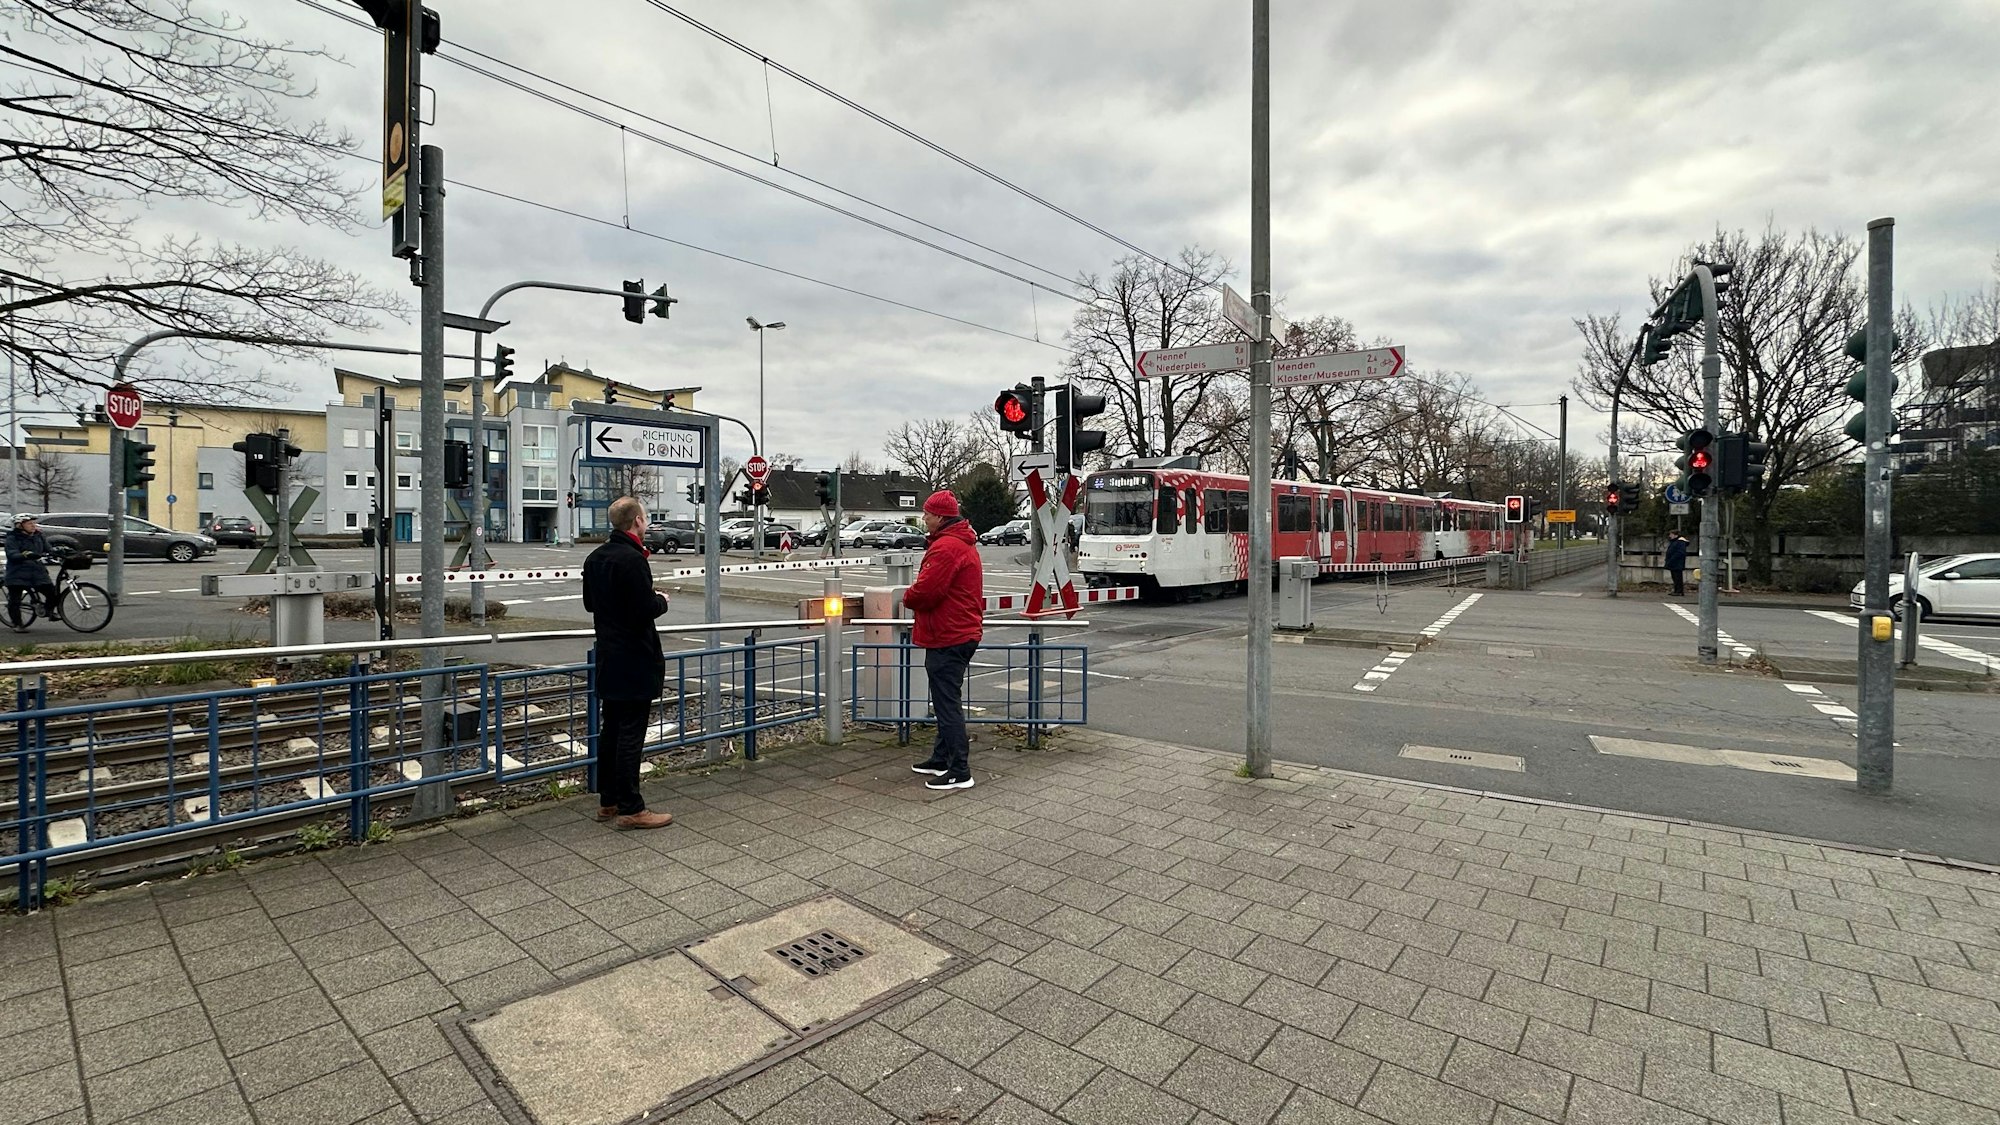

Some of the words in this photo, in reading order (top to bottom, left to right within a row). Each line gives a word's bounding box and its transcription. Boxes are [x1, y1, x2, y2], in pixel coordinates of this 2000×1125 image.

[1156, 351, 1187, 361] Hennef
[1156, 362, 1207, 373] Niederpleis
[1277, 361, 1316, 372] Menden
[1277, 369, 1360, 383] Kloster/Museum
[109, 394, 140, 417] STOP
[642, 429, 693, 444] RICHTUNG
[648, 442, 693, 459] BONN
[748, 462, 766, 473] STOP
